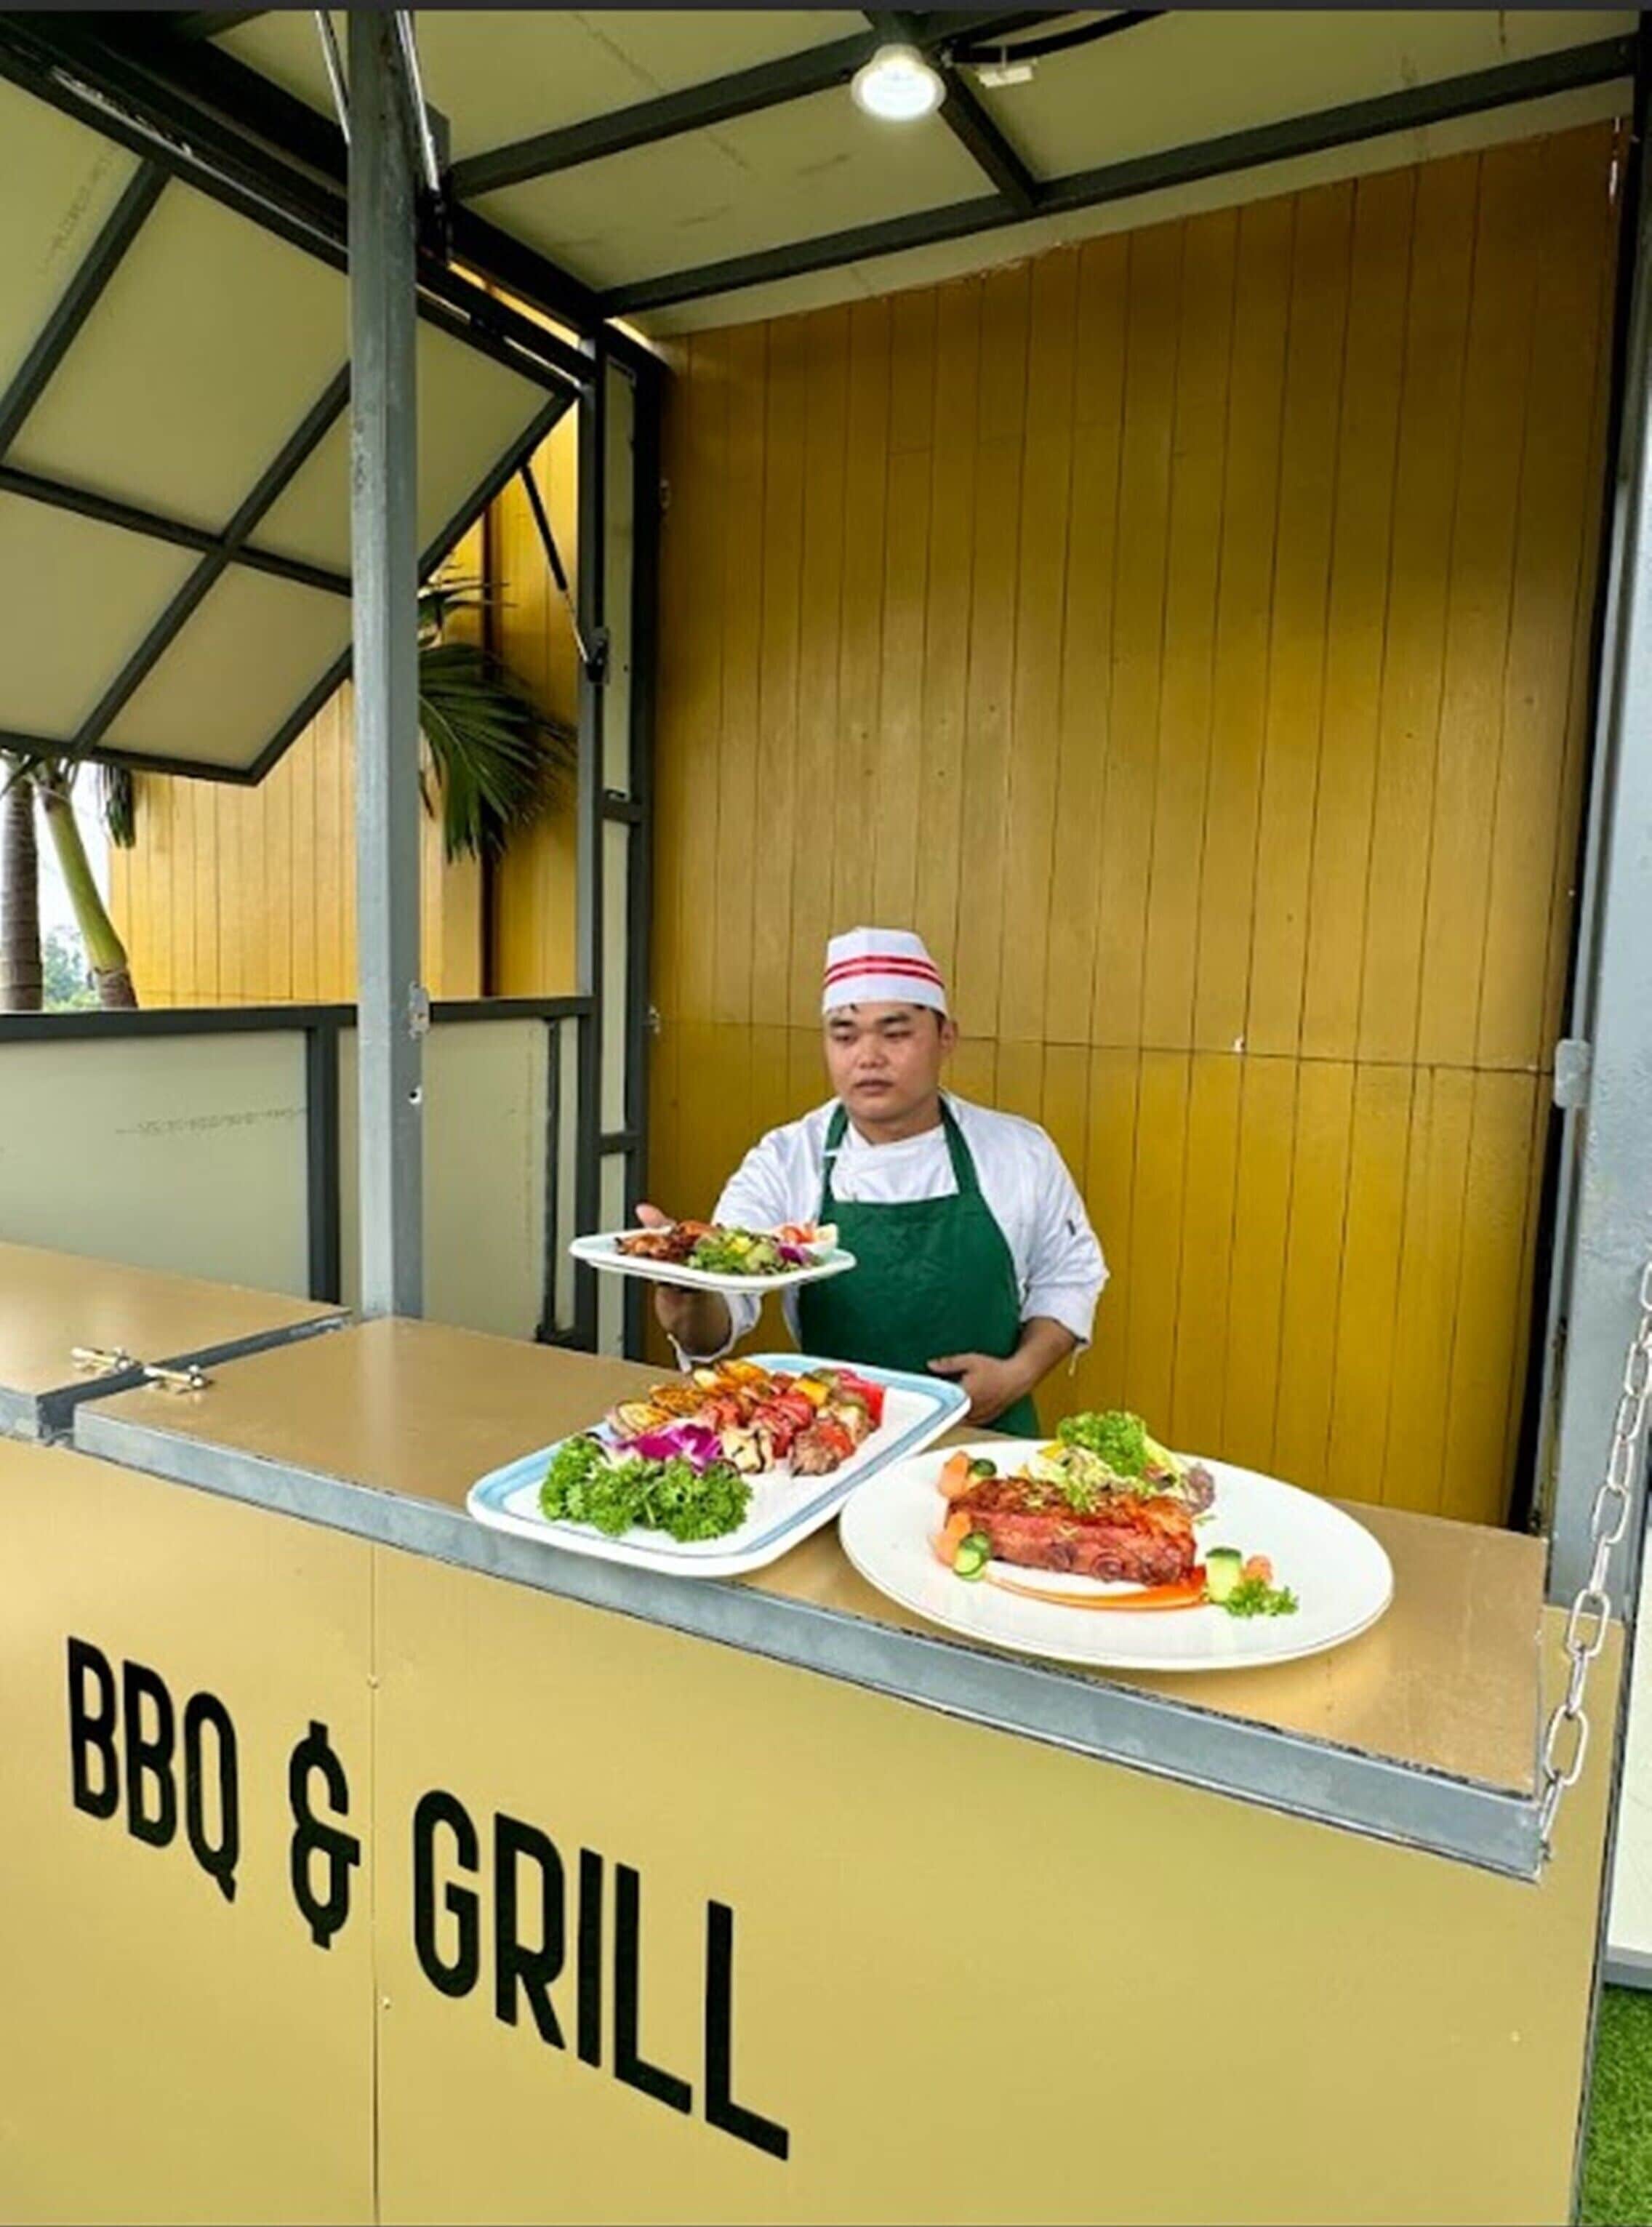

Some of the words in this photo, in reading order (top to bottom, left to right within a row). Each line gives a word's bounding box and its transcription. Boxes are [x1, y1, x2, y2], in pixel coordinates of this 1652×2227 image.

[68, 1637, 238, 1902] BBQ
[289, 1720, 360, 1949] &
[414, 1790, 789, 2161] GRILL
